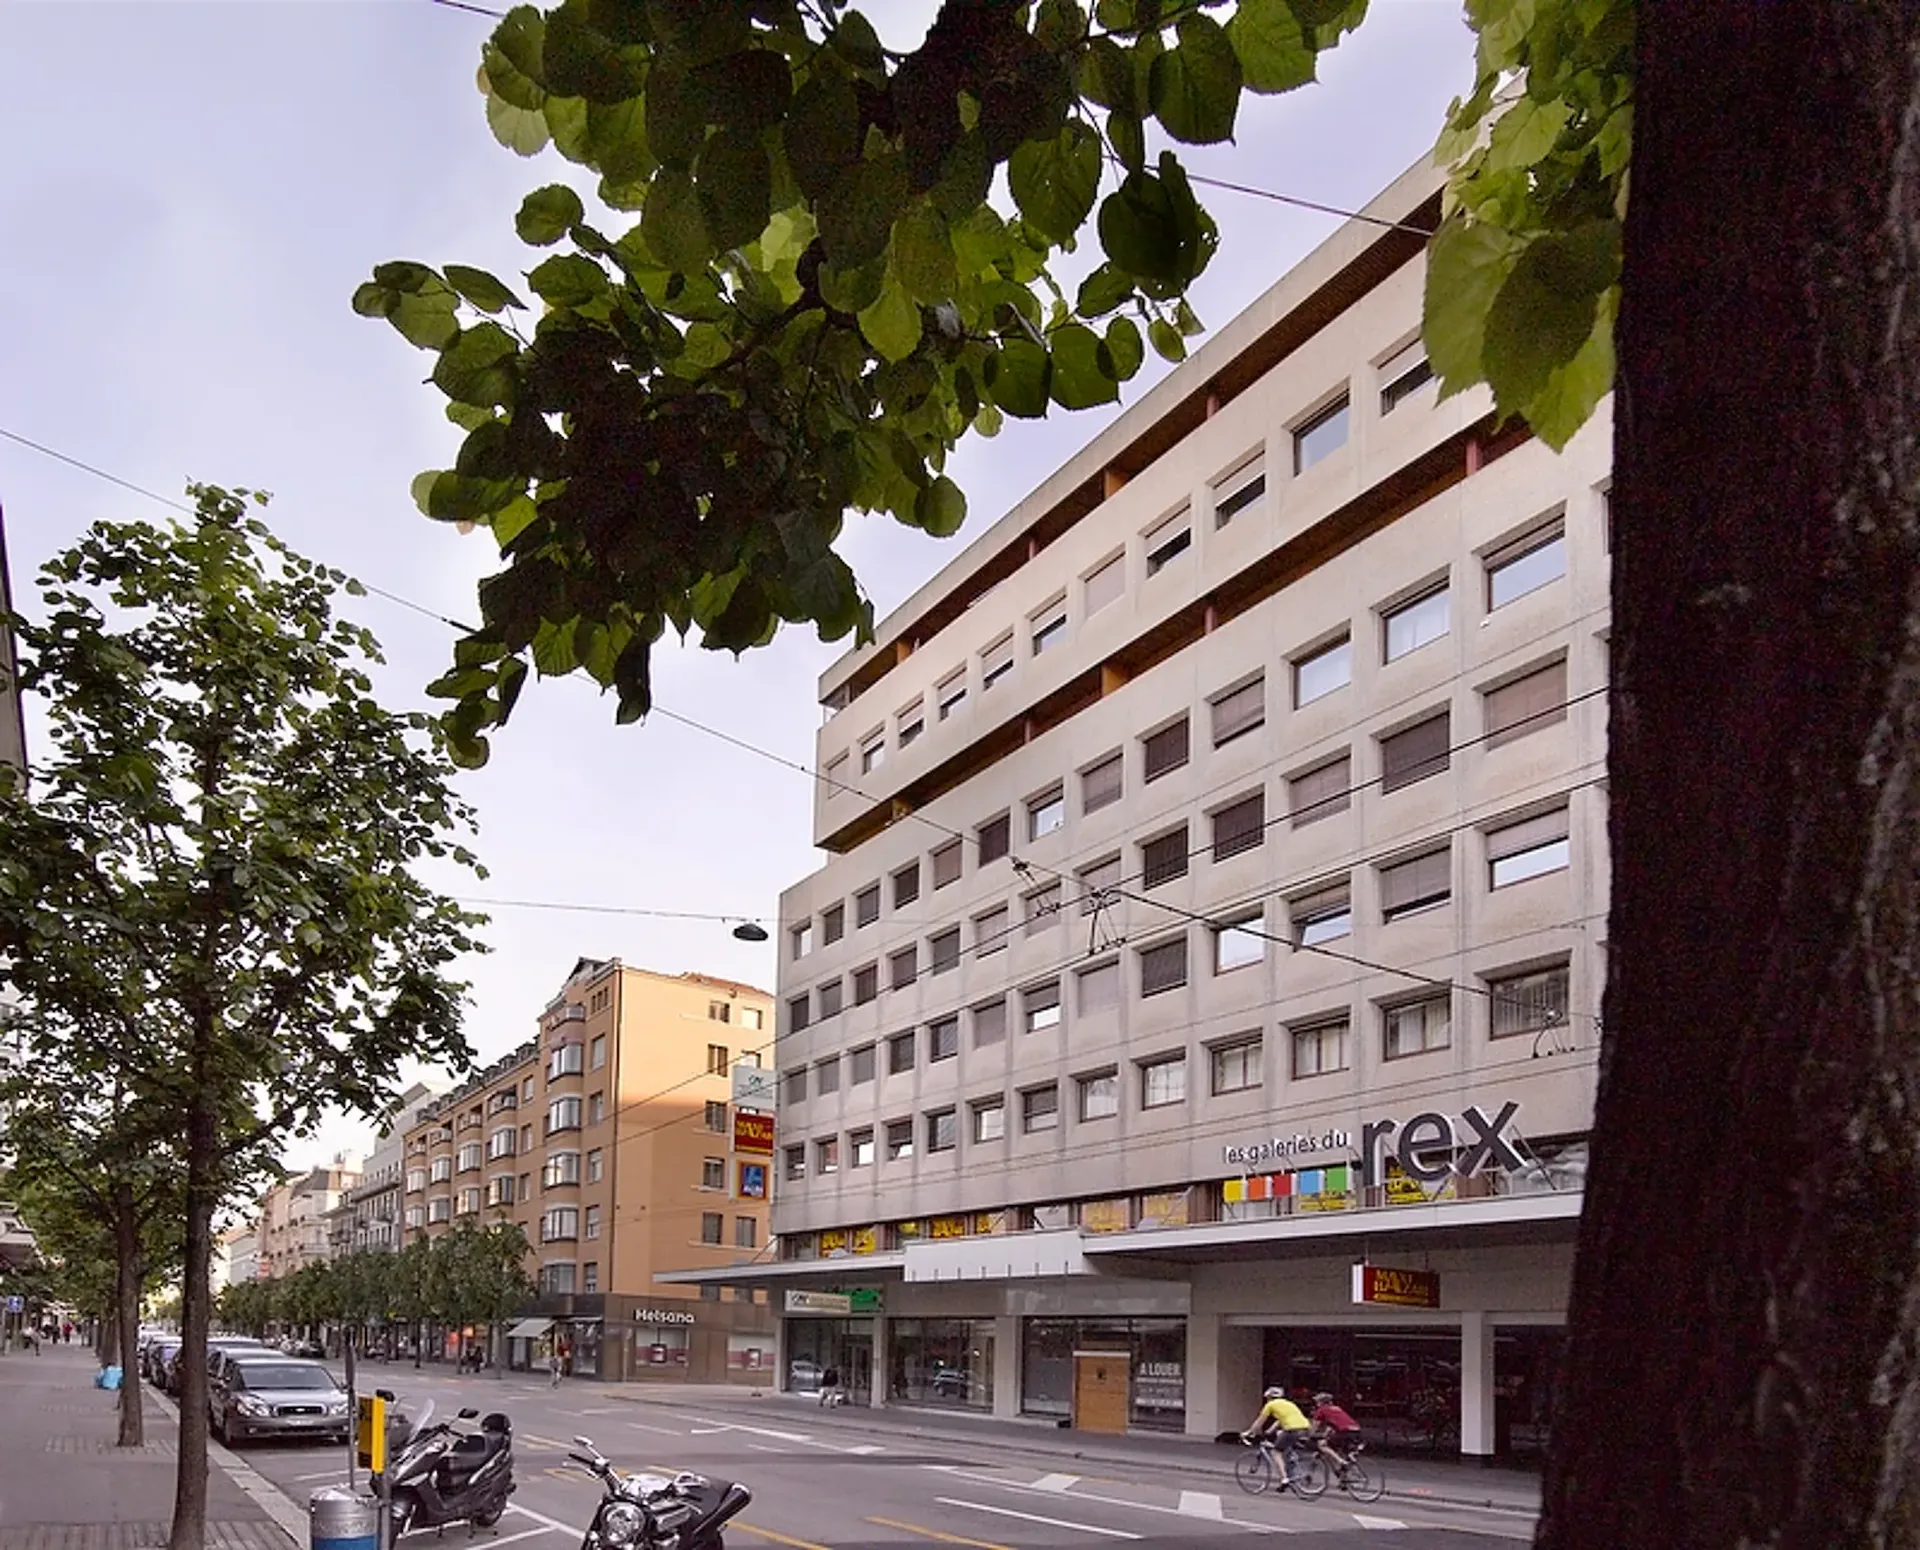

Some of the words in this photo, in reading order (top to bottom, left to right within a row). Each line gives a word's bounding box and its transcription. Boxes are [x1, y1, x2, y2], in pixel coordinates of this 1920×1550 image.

[1223, 1146, 1244, 1163] les
[1248, 1134, 1316, 1166] galeries
[1322, 1129, 1348, 1150] du
[1362, 1101, 1527, 1187] rex
[634, 1308, 695, 1324] Helsana
